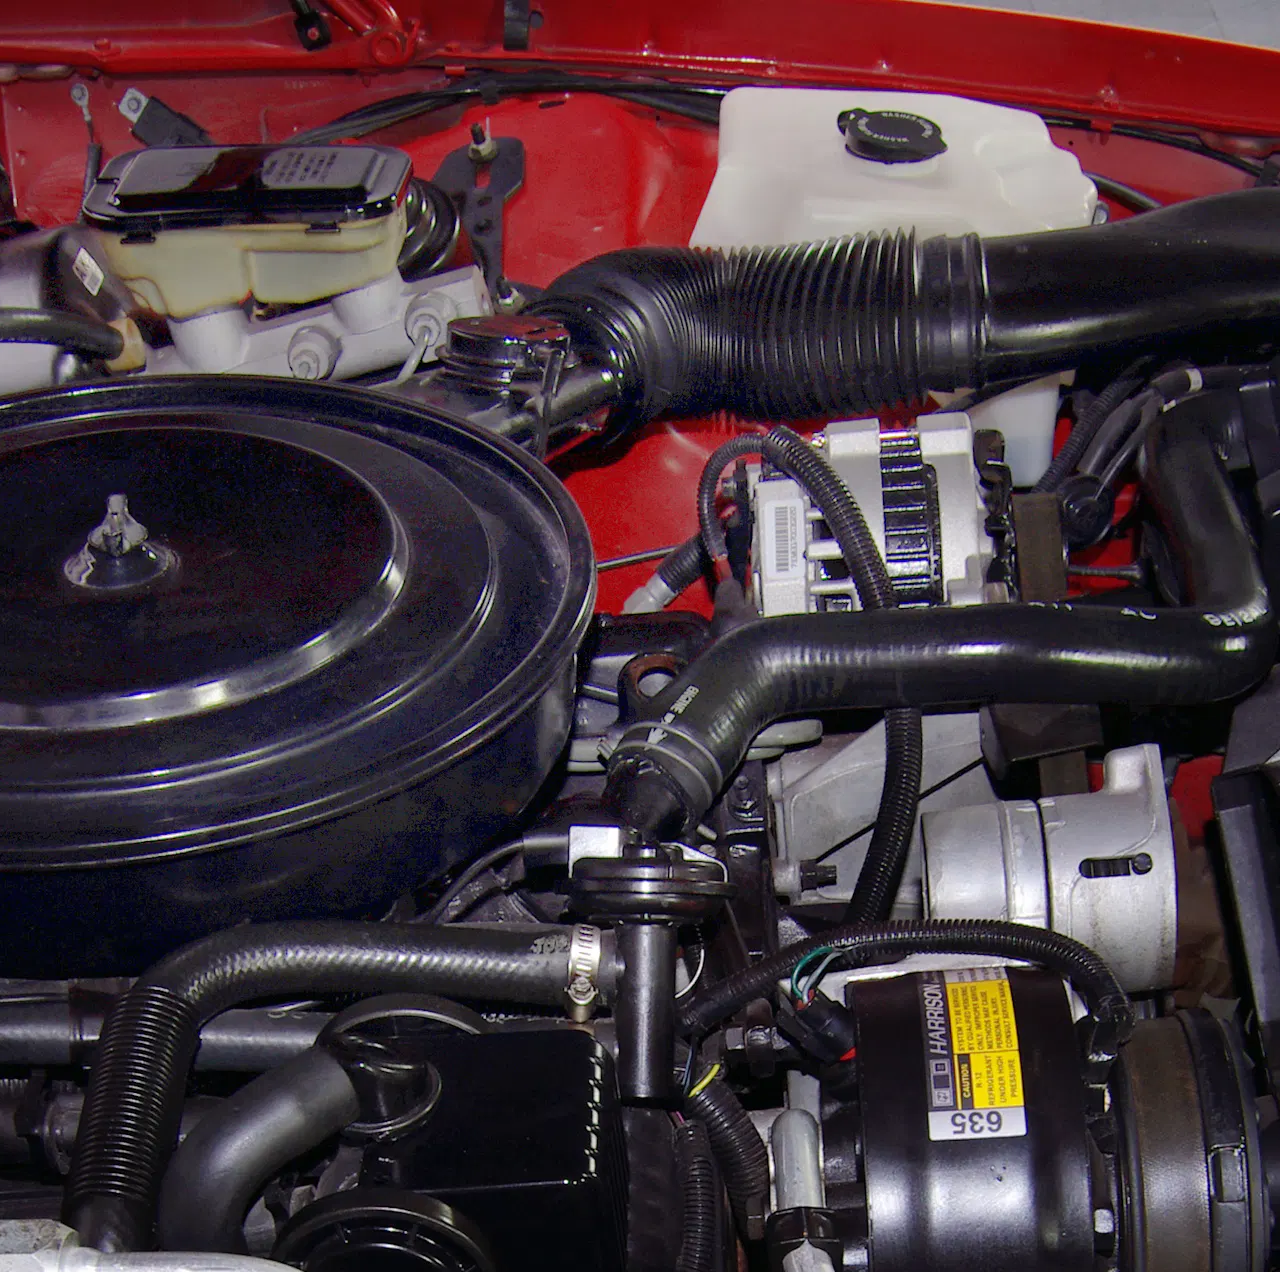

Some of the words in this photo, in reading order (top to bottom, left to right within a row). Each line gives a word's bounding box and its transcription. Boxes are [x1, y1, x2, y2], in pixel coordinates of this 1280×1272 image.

[922, 983, 947, 1054] HARRISON
[973, 1003, 981, 1030] IMPROPER
[1001, 998, 1009, 1018] SERVICE
[956, 1026, 964, 1051] SYSTEM
[964, 1011, 973, 1040] QUALIFIED
[985, 1019, 993, 1049] METHODS
[994, 1017, 1002, 1048] PERSONAL
[1004, 1019, 1013, 1047] CONSULT
[968, 1041, 974, 1050] BY
[960, 1064, 970, 1098] CAUTION
[984, 1055, 995, 1105] REFRIGERANT
[998, 1076, 1006, 1102] UNDER
[1008, 1059, 1017, 1097] PRESSURE
[950, 1109, 1002, 1136] 635
